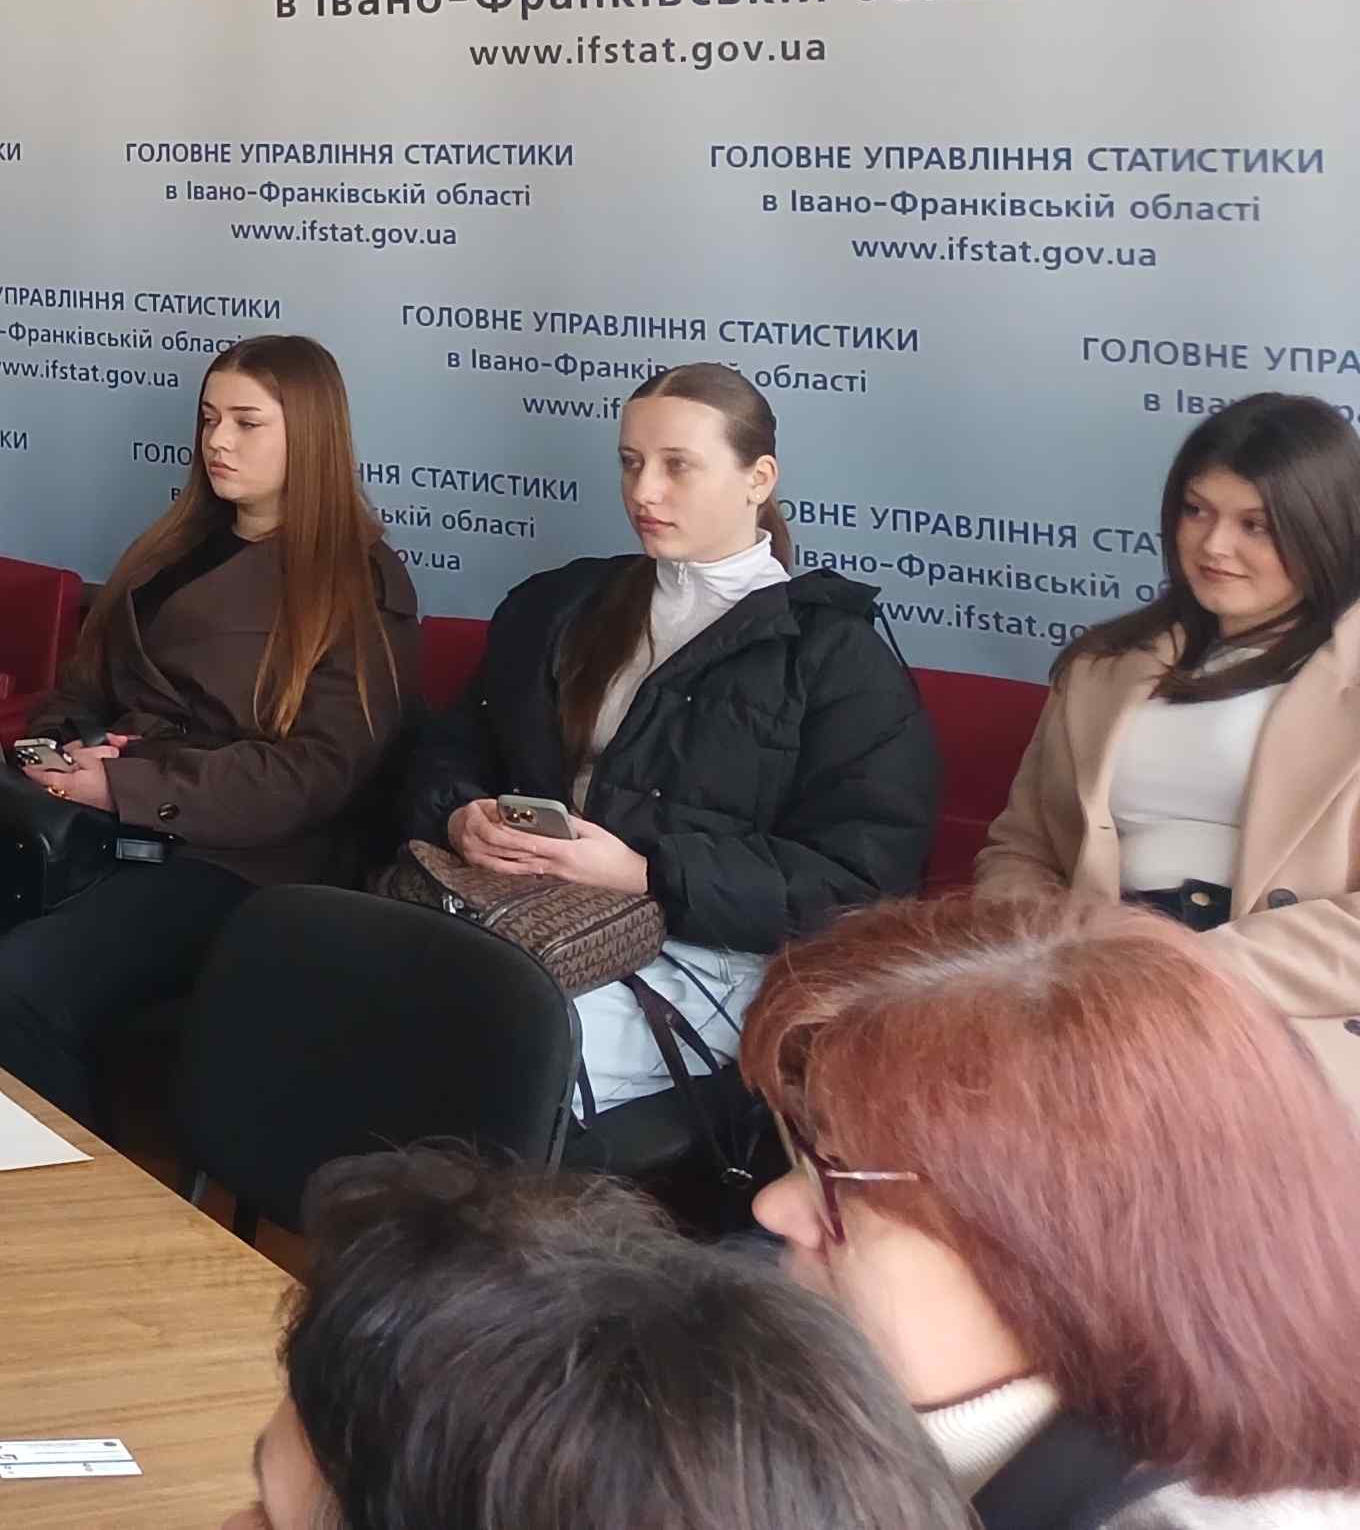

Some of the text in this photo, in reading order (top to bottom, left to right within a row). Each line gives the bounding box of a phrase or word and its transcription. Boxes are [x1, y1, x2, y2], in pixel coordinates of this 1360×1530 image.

[469, 35, 825, 70] www.ifstat.gov.ua
[126, 143, 572, 166] ГОЛОВНЕ УПРАВЛІННЯ СТАТИСТИКИ
[711, 146, 1323, 173] ГОЛОВНЕ УПРАВЛІННЯ СТАТИСТИКИ
[166, 180, 530, 207] в Івано-Франківській області
[763, 190, 1259, 221] в Івано-Франківській області
[231, 220, 456, 249] www.ifstat.gov.ua
[852, 236, 1156, 270] www.ifstat.gov.ua
[135, 293, 279, 319] СТАТИСТИКИ
[403, 305, 917, 352] ГОЛОВНЕ УПРАВЛІННЯ СТАТИСТИКИ
[1084, 337, 1248, 369] ГОЛОВНЕ
[448, 352, 460, 367] в
[755, 364, 866, 392] області
[1144, 394, 1160, 411] в
[133, 442, 192, 465] ГОЛО
[410, 467, 577, 502] СТАТИСТИКИ
[442, 510, 534, 538] області
[777, 499, 857, 529] ОВНЕ
[870, 507, 1076, 548] УПРАВЛІННЯ
